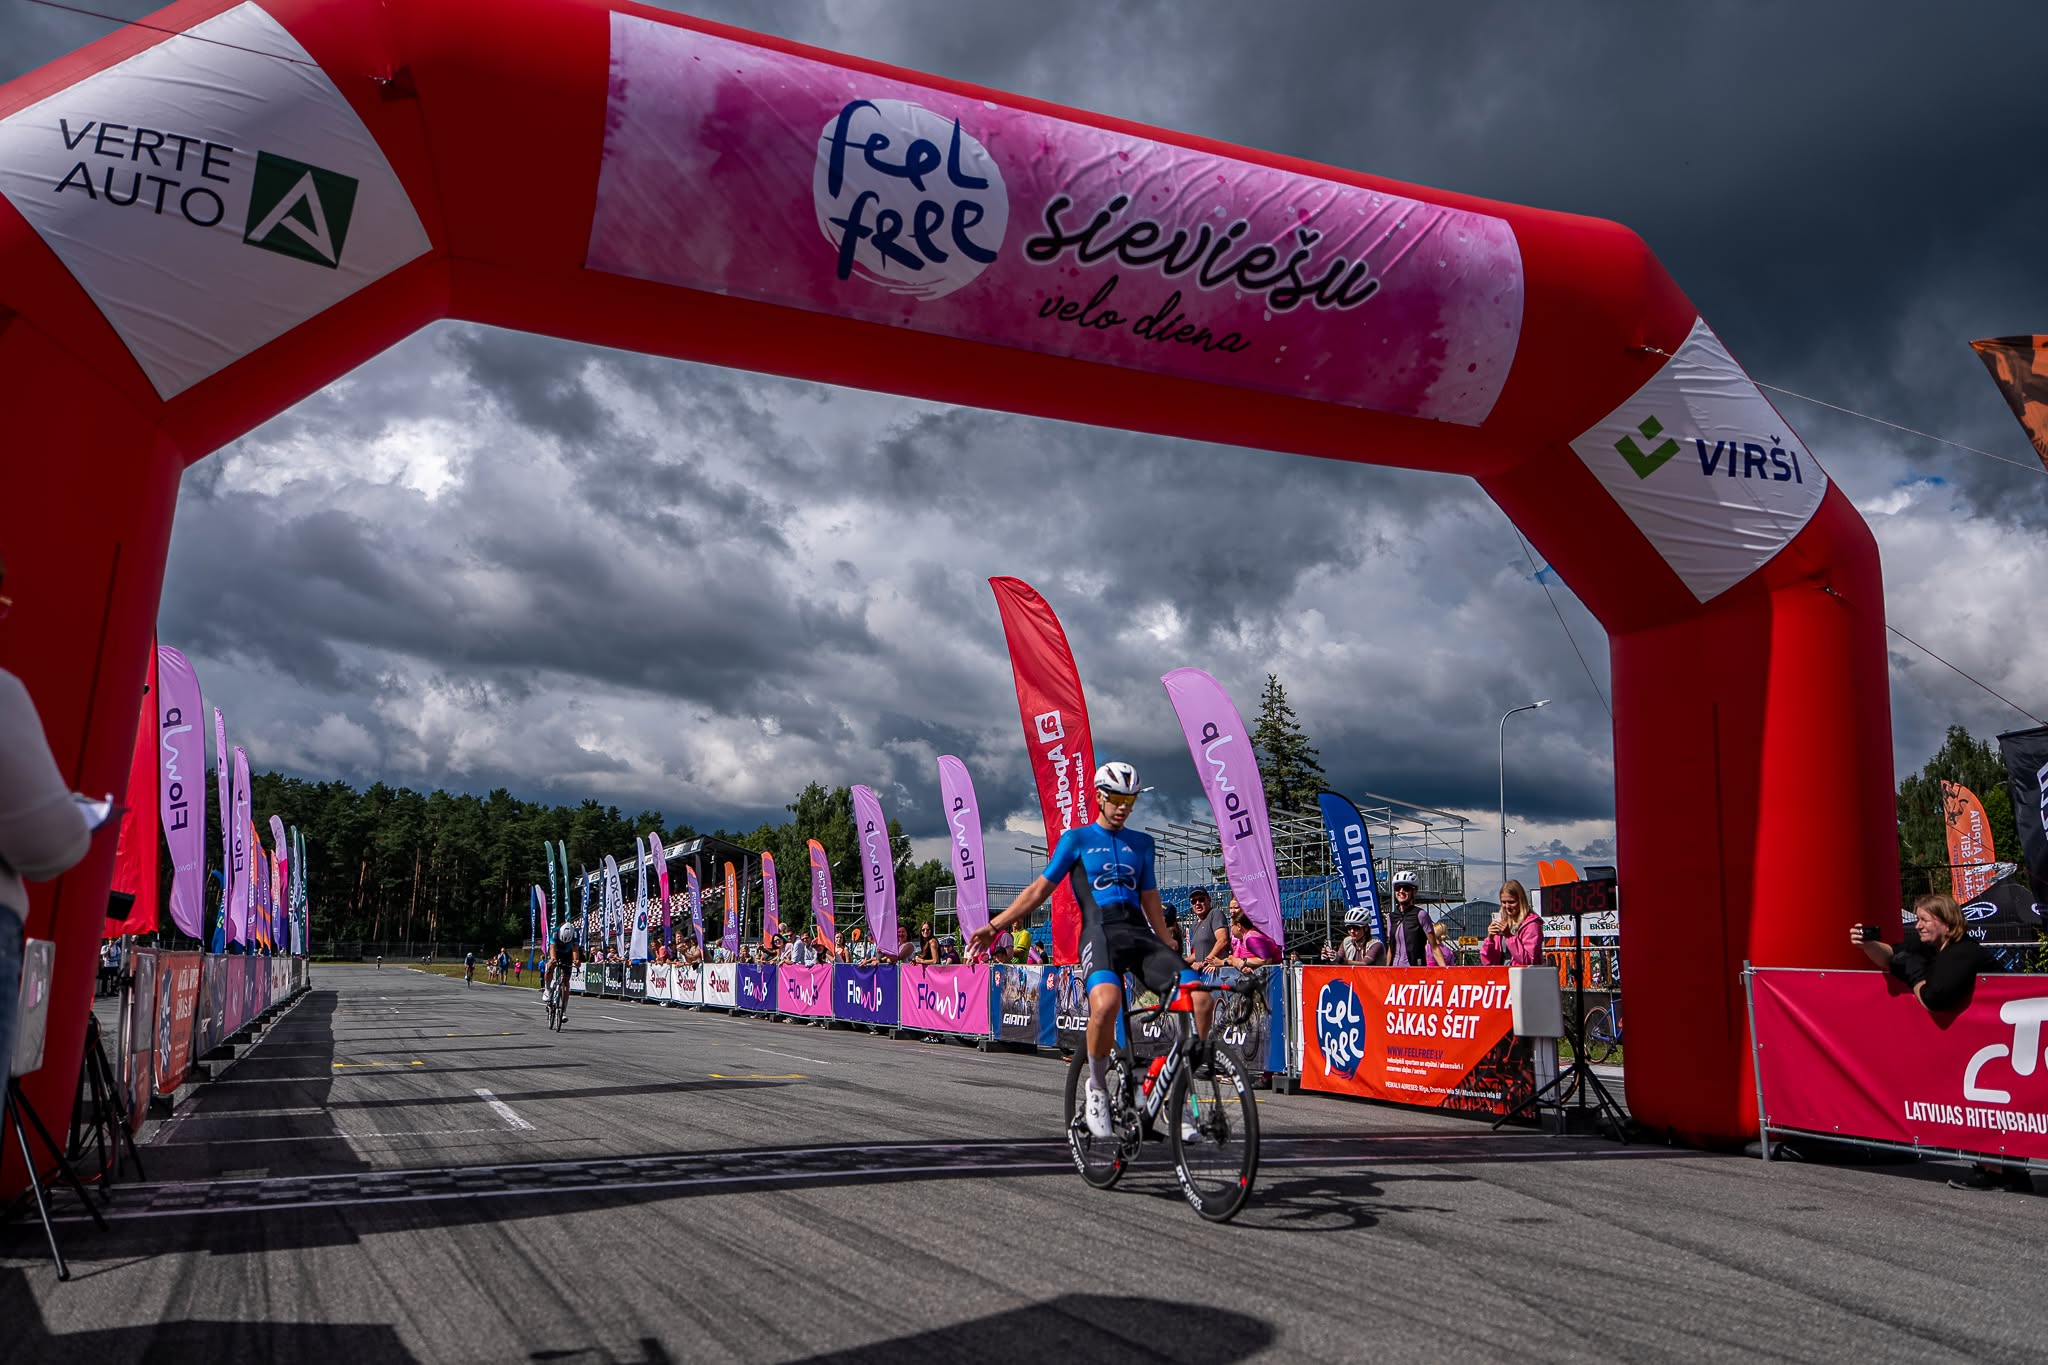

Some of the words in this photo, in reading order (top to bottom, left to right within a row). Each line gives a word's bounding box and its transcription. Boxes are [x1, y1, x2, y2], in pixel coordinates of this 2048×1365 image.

[58, 118, 234, 184] VERTE
[822, 99, 989, 199] feel
[53, 160, 226, 228] AUTO
[829, 190, 998, 281] free
[1026, 194, 1379, 310] sieviešu
[1039, 274, 1127, 334] velo
[1133, 290, 1253, 354] diena
[1696, 434, 1803, 484] VIRŠI
[1967, 926, 1987, 941] ody
[1316, 981, 1361, 1040] feel
[1384, 980, 1445, 1008] AKTĪVĀ
[1003, 1013, 1031, 1027] GIANT
[1056, 1015, 1091, 1031] CADE
[1386, 1008, 1439, 1037] SĀKAS
[1441, 1009, 1480, 1039] ŠEIT
[1321, 1028, 1365, 1076] free
[1904, 1100, 1964, 1127] LATVIJAS
[1965, 1106, 2048, 1135] RITEŅBRAU
